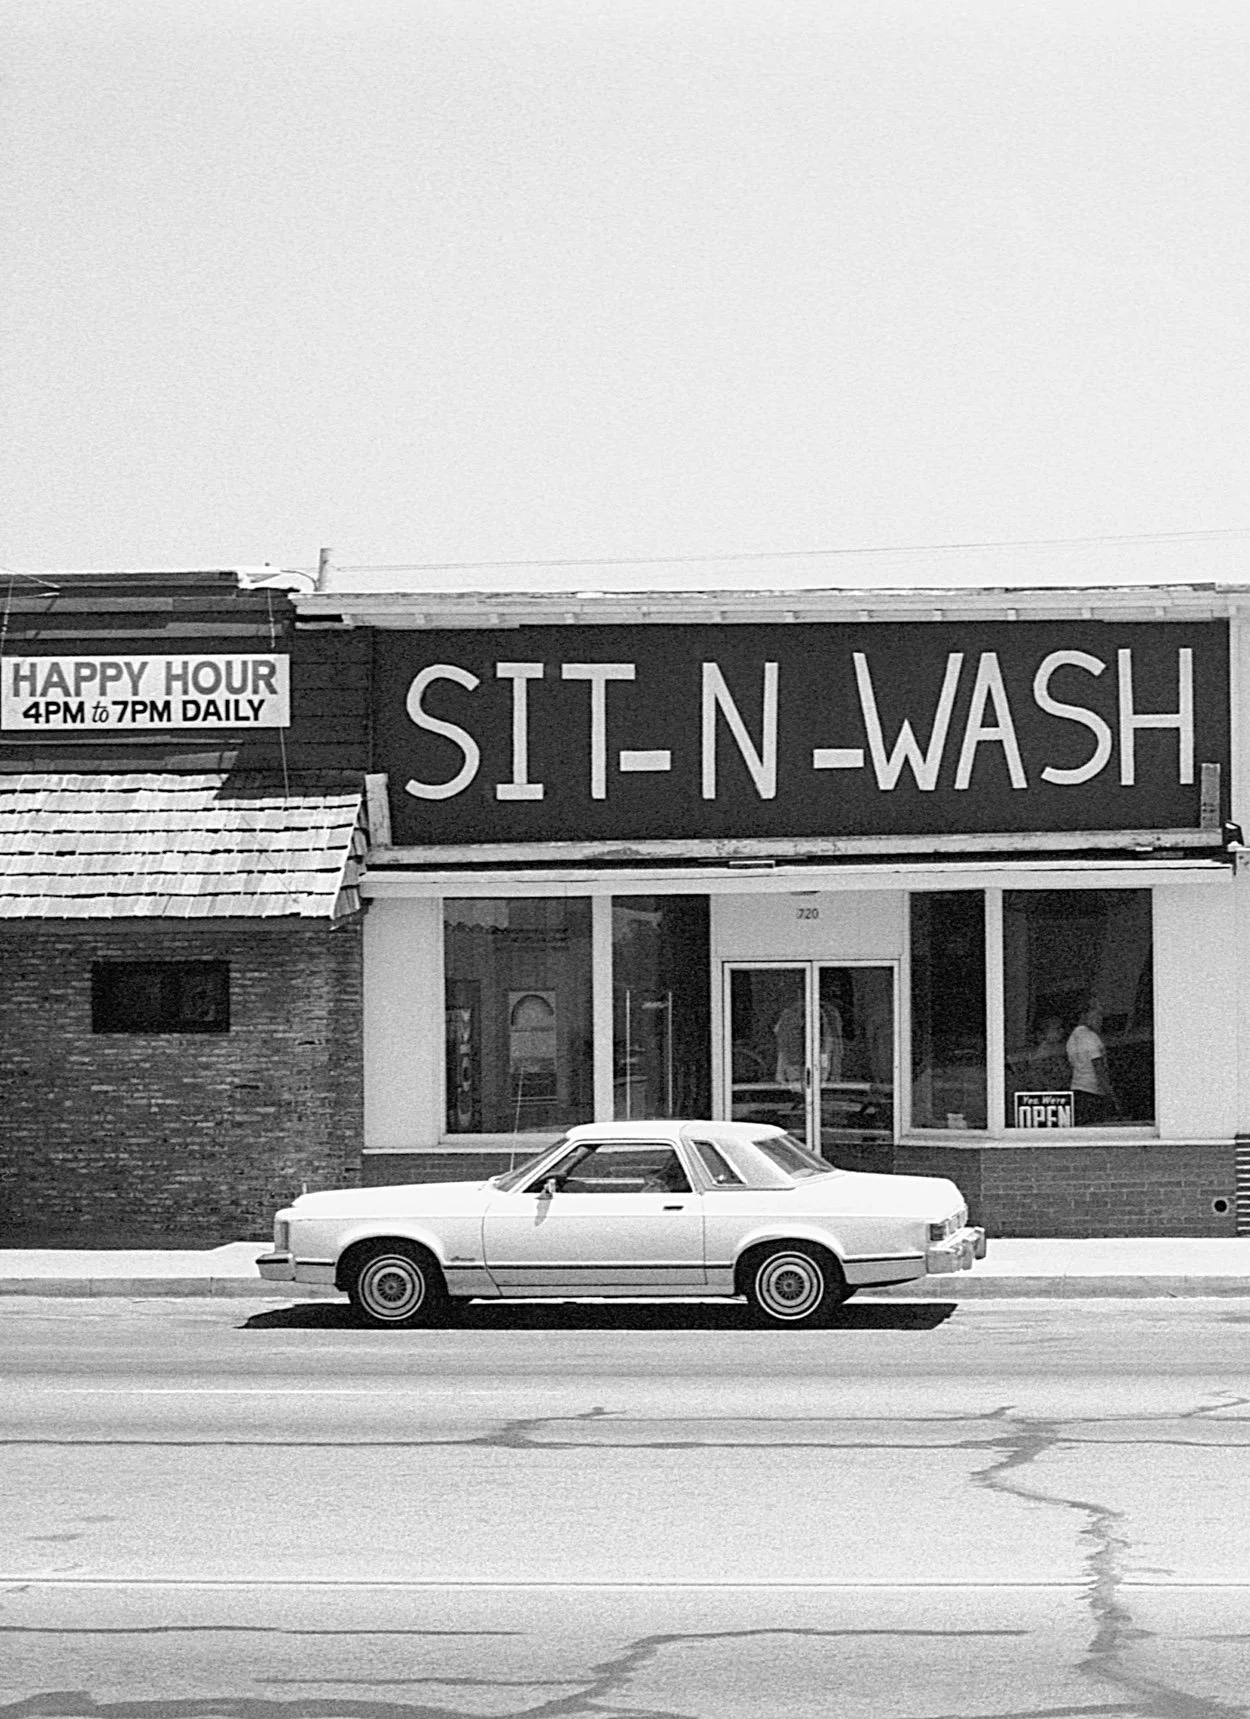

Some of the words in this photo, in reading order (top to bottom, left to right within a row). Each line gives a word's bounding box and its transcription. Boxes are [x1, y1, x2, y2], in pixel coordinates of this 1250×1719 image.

[12, 662, 149, 697] HAPPY
[165, 660, 278, 696] HOUR
[22, 701, 85, 724] 4PM
[92, 704, 109, 723] to
[111, 700, 171, 723] 7PM
[182, 699, 265, 721] DAILY
[796, 908, 819, 919] 720
[1019, 1106, 1070, 1128] OPEN
